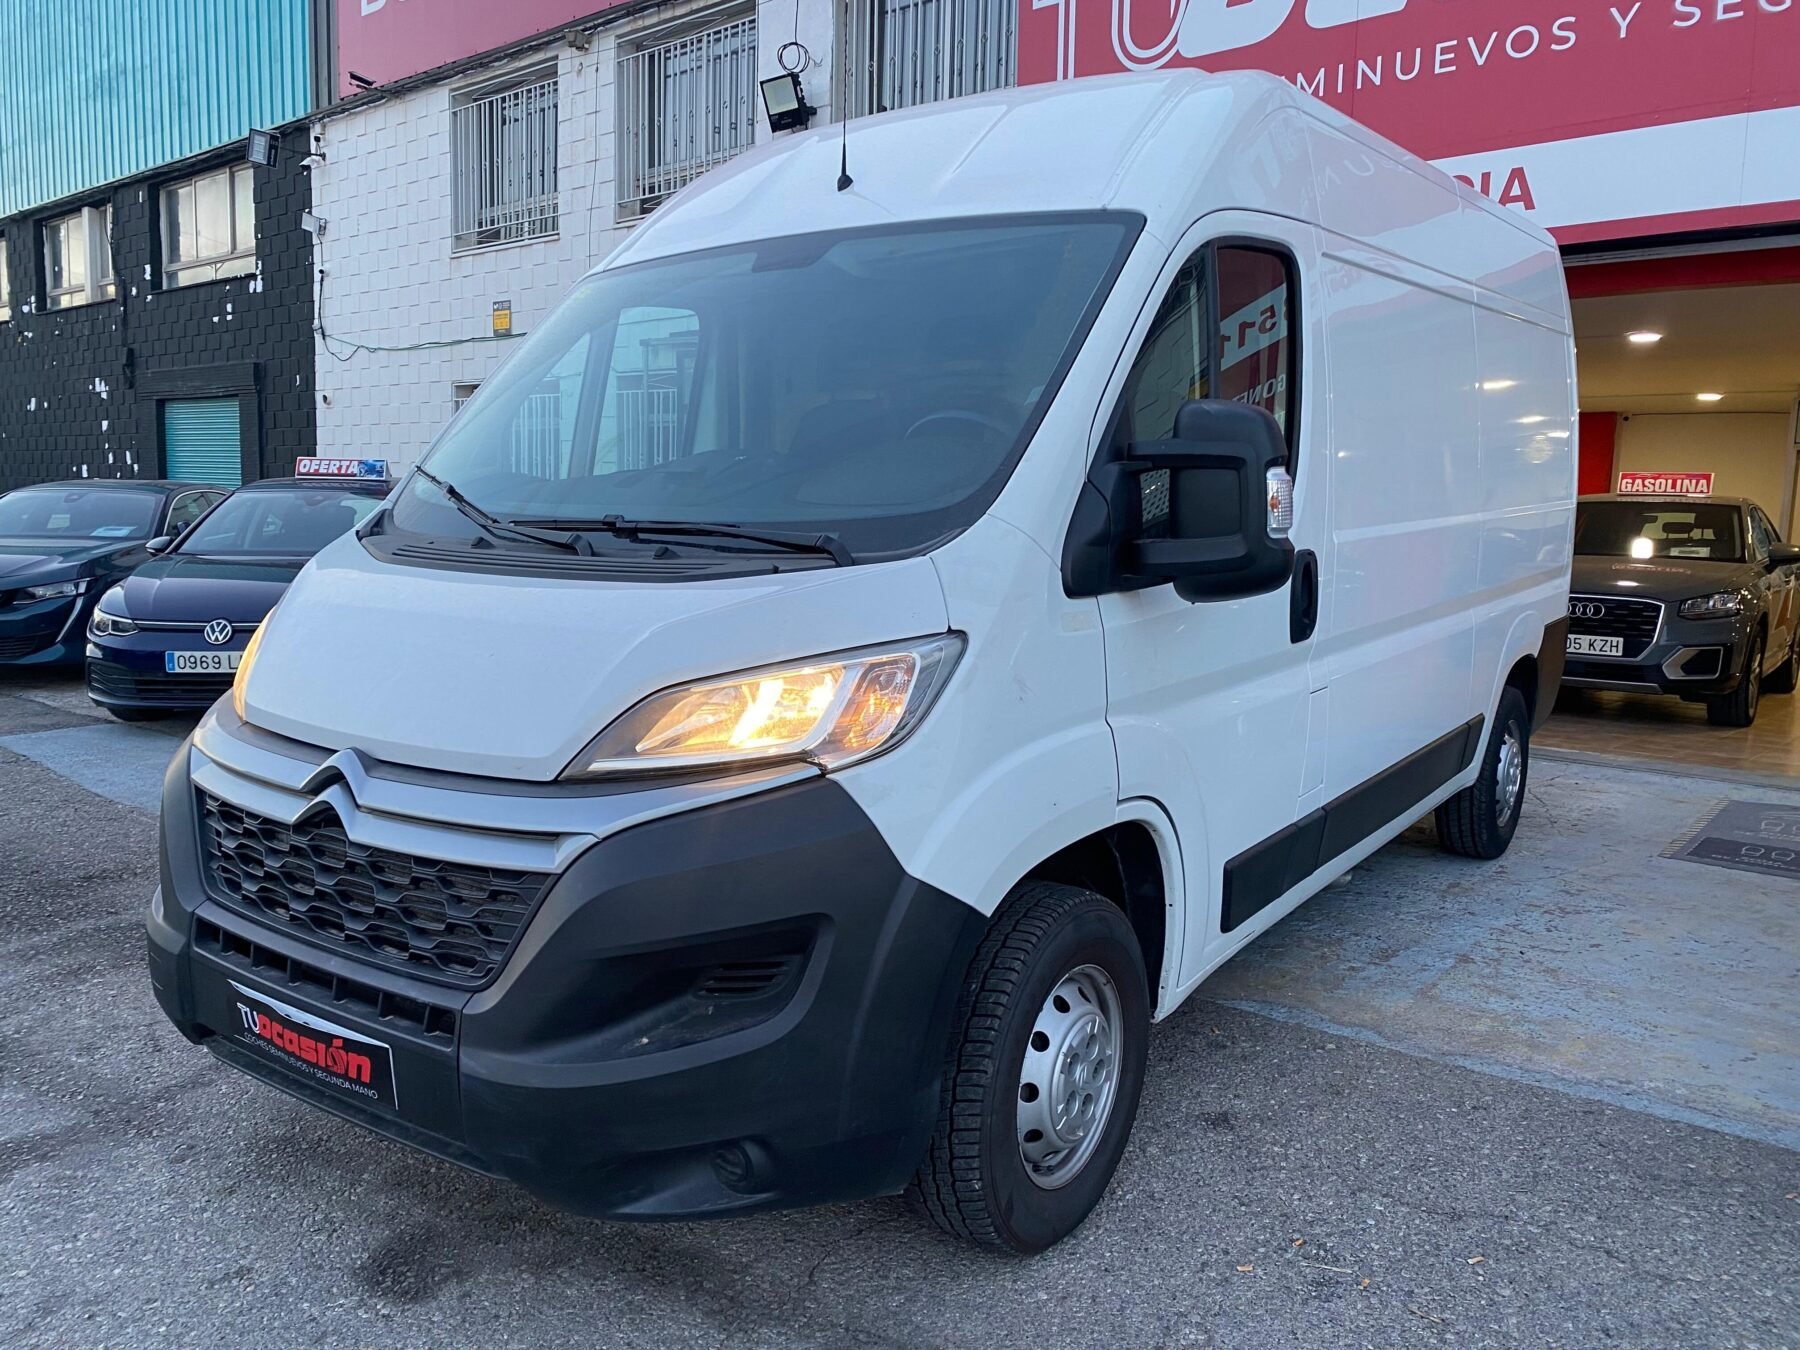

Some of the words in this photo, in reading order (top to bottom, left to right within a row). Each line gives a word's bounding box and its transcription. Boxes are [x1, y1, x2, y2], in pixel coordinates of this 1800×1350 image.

[1277, 16, 1577, 97] MINUEVOS
[1610, 2, 1642, 39] Y
[300, 459, 359, 474] OFERTA
[1621, 478, 1709, 493] GASOLINA
[1588, 638, 1620, 653] KZH
[176, 654, 222, 670] 0969
[228, 654, 243, 670] L
[314, 1068, 352, 1091] SEGUNDA
[351, 1083, 379, 1100] MANO
